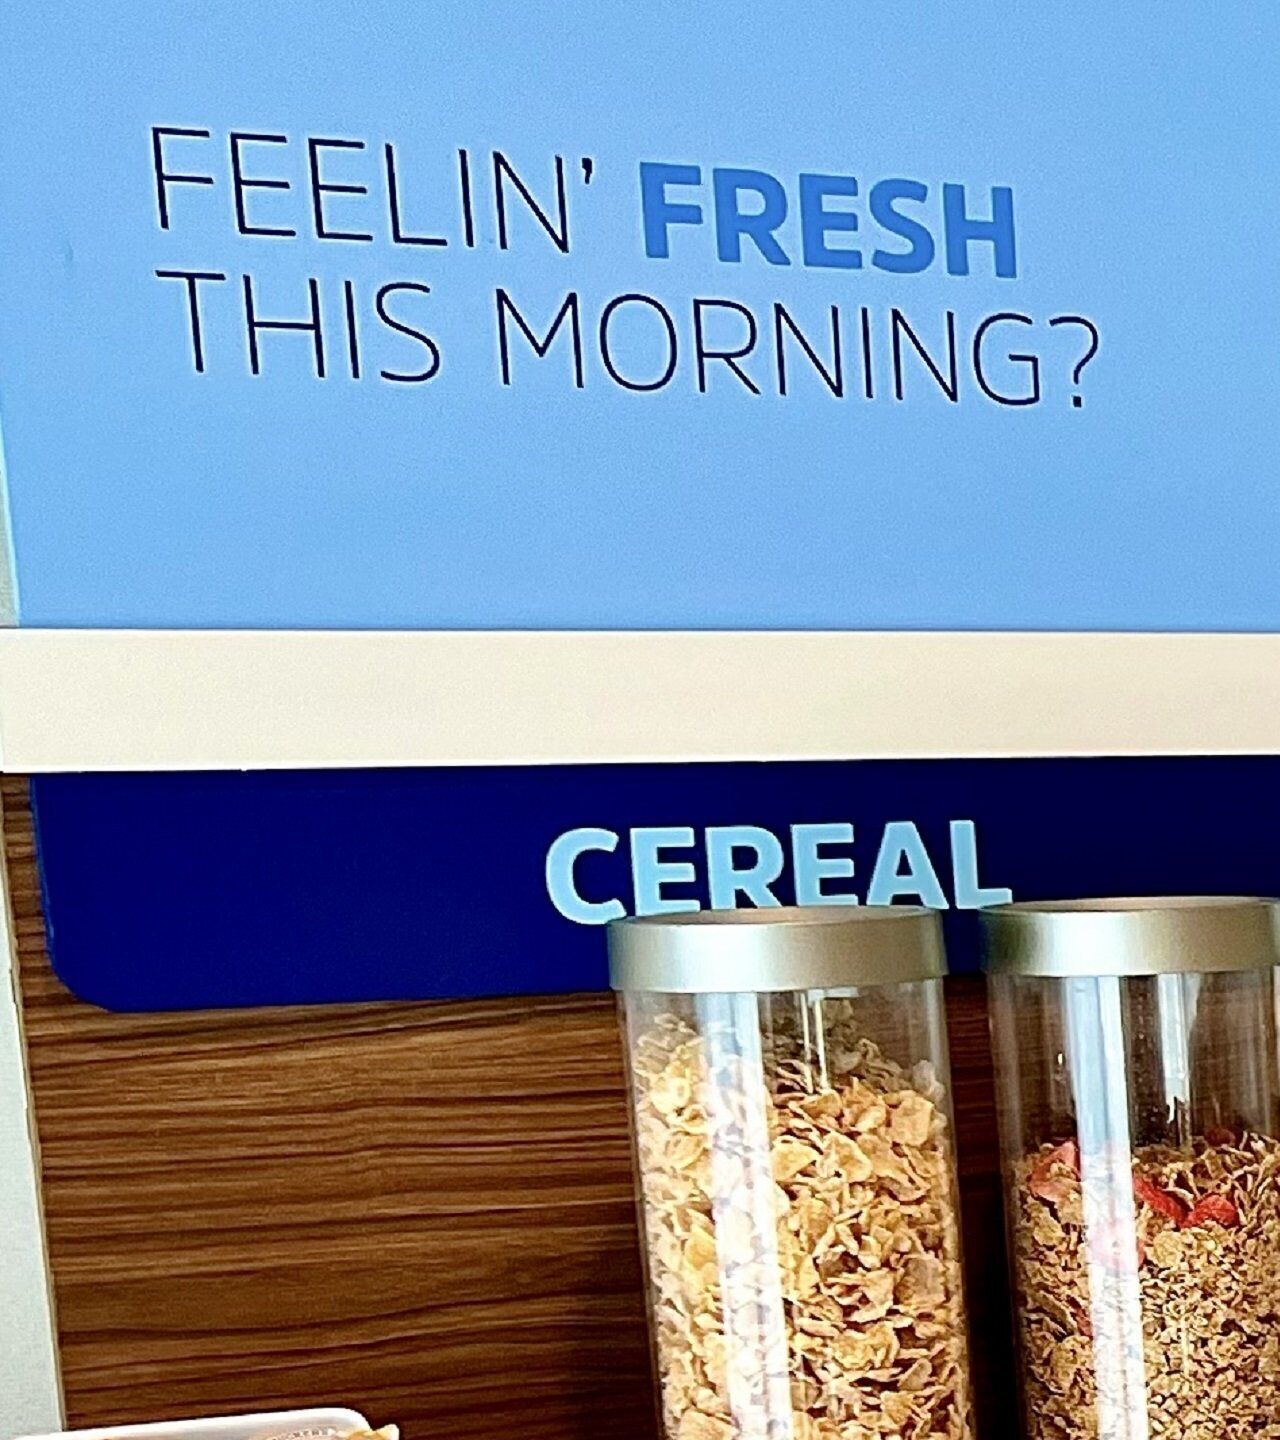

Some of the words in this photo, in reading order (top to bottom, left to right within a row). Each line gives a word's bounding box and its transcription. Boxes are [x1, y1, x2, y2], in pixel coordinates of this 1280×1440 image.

[150, 125, 597, 255] FEELIN'
[638, 161, 1019, 279] FRESH
[154, 268, 442, 383] THIS
[494, 285, 1100, 409] MORNING?
[544, 819, 1014, 926] CEREAL
